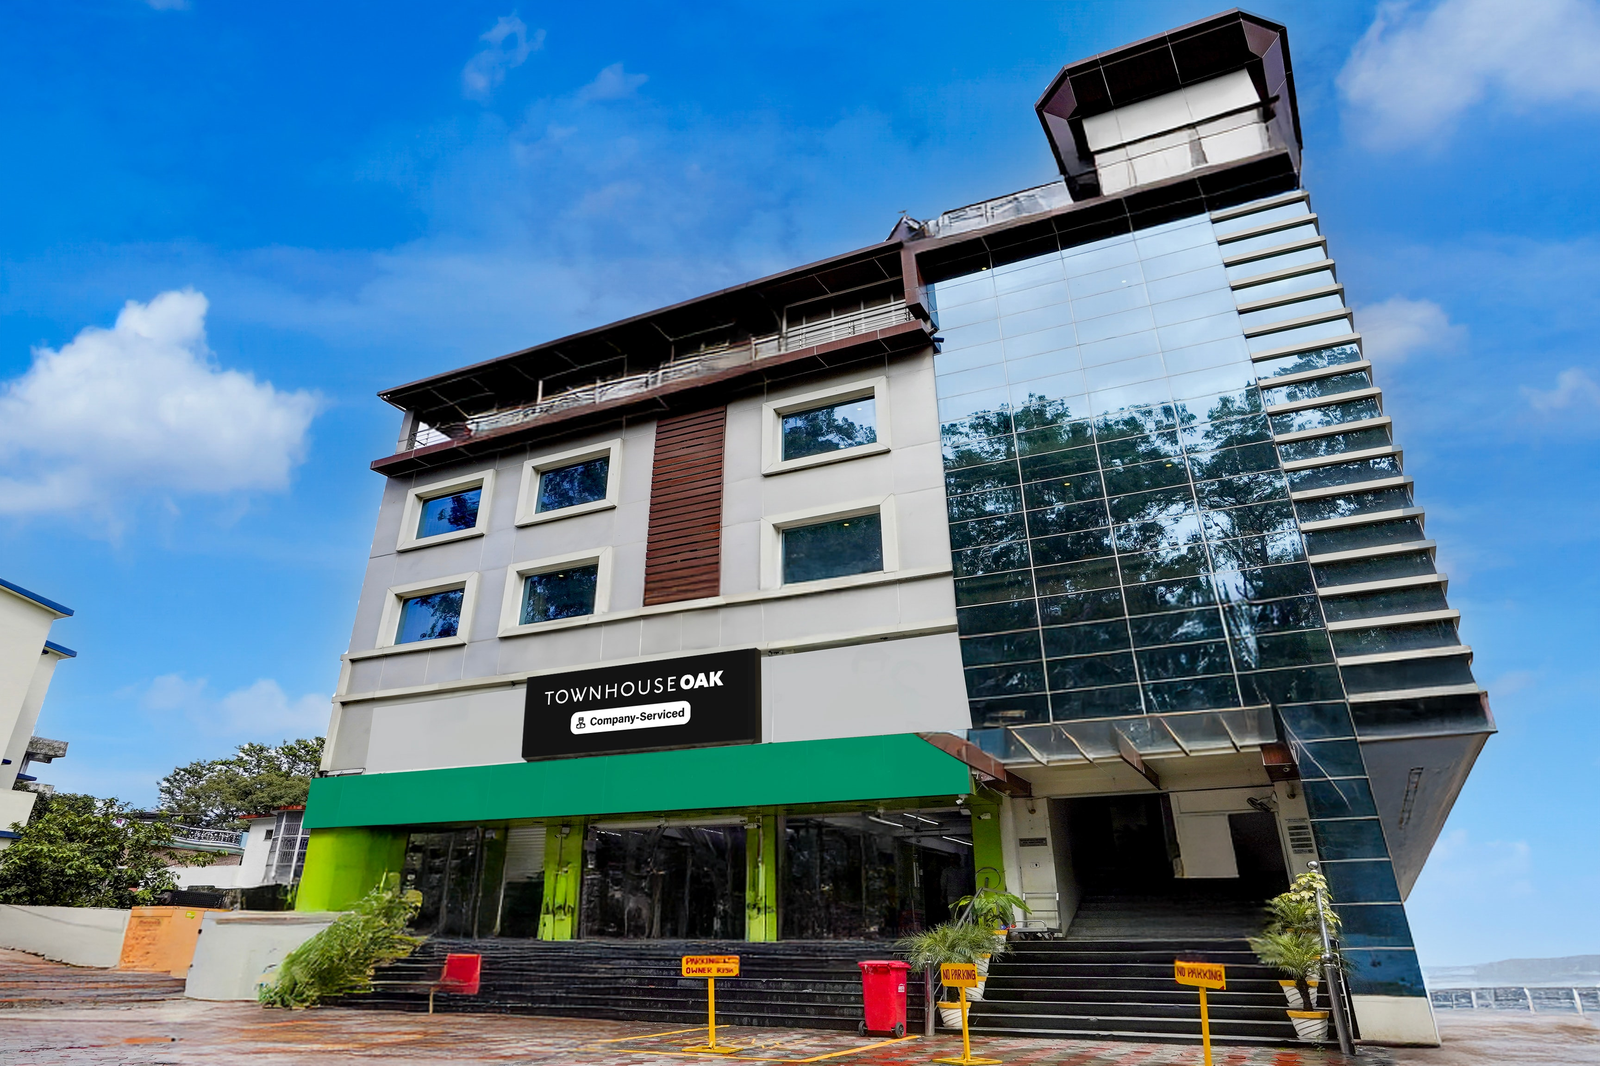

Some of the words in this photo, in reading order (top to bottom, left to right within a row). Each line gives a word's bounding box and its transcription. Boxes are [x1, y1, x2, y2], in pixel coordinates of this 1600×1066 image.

[545, 676, 677, 706] TOWNHOUSE
[680, 670, 724, 690] OAK
[590, 707, 685, 727] Company-Serviced
[685, 957, 721, 965] PARKIN
[942, 969, 950, 980] NO
[951, 969, 976, 980] PARKING
[1176, 966, 1186, 977] NO
[1188, 967, 1223, 982] PARKING
